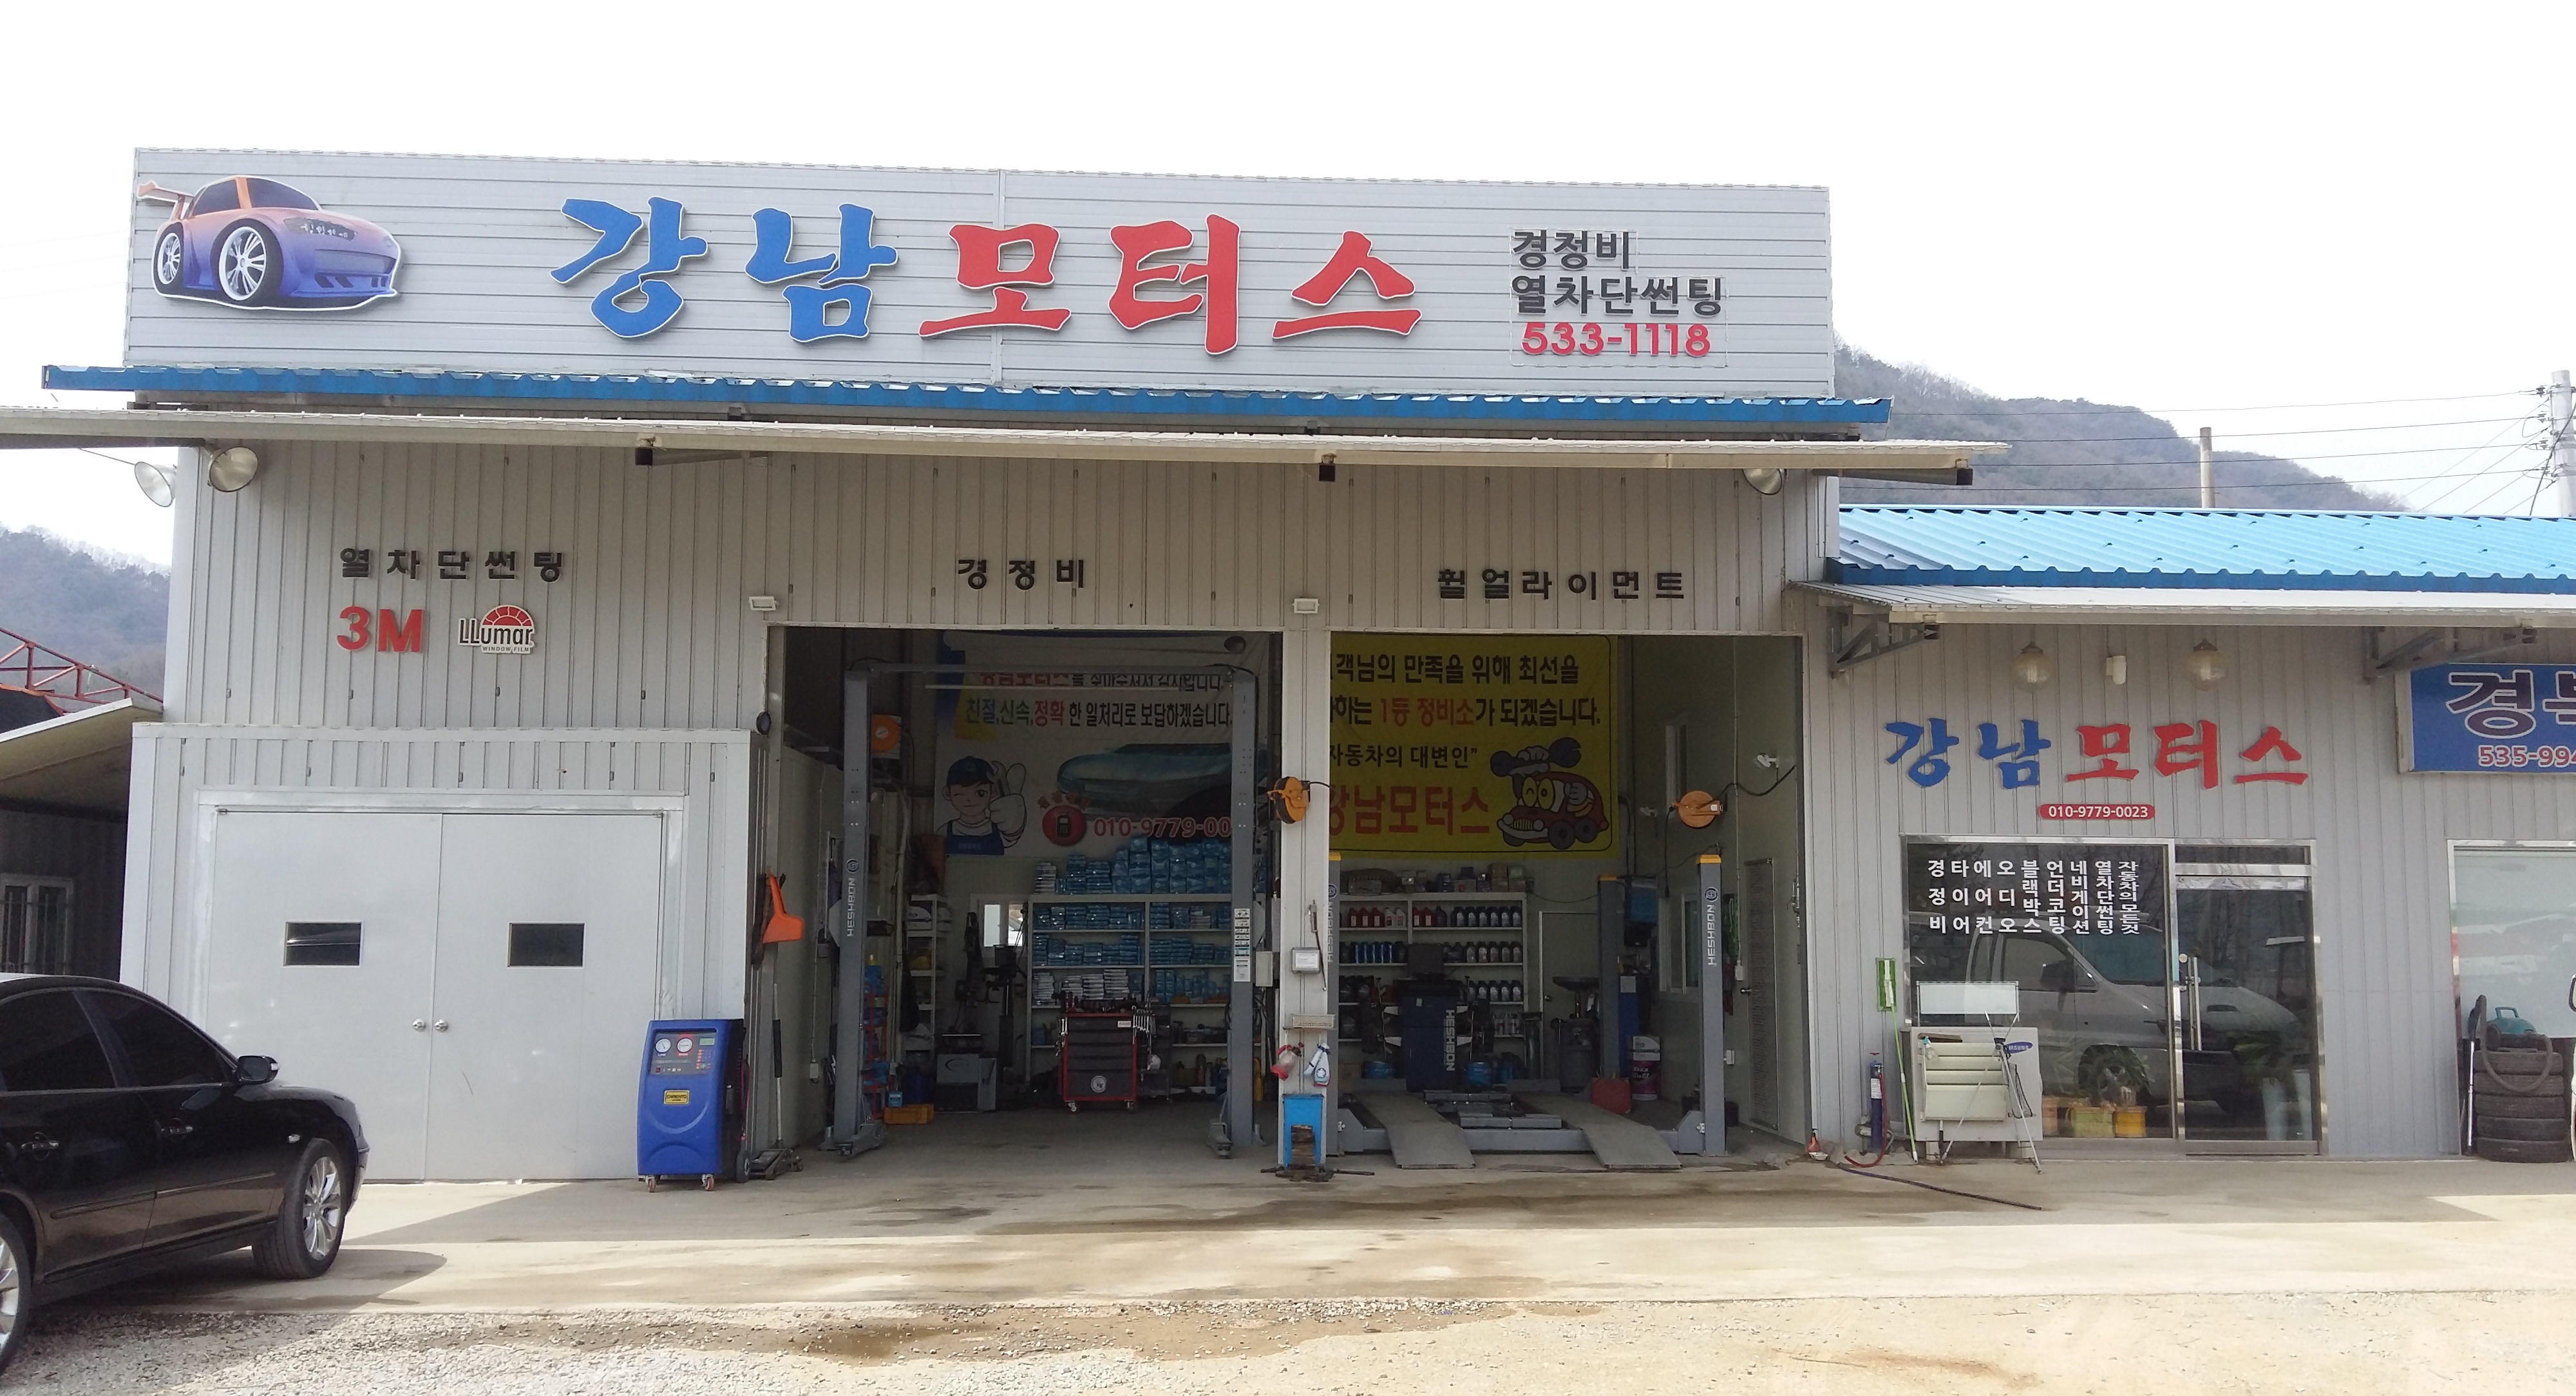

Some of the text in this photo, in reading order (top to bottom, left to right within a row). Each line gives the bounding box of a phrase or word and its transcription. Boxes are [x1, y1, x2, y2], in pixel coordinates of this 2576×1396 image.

[549, 195, 1423, 356] 강남모터스
[1511, 229, 1630, 271] 경정비
[1511, 274, 1722, 318] 열차단썬팅
[1520, 321, 1711, 357] 533-1118
[340, 547, 563, 582] 열차단썬팅
[958, 559, 1084, 590] 경정비
[1437, 569, 1685, 601] 휠얼라이먼트
[337, 606, 423, 652] 3M
[459, 619, 533, 645] LLumar
[1331, 654, 1579, 684] 객님의 만족을 위해 최선을
[1086, 702, 1136, 727] 일처리로
[1141, 703, 1233, 728] 보답하겠습니다.
[1331, 695, 1600, 728] 하는 1등 정비소가 되겠습니다.
[1885, 717, 2308, 789] 강남모터스
[1093, 816, 1231, 838] 010-9779-00
[1329, 785, 1490, 836] 강남모터스
[2049, 806, 2148, 818] 010-9779-0023
[847, 878, 856, 937] HESHBON
[1927, 860, 1947, 934] 경정비
[1951, 860, 1970, 934] 타이어
[1973, 860, 1993, 934] 에어컨
[1996, 860, 2018, 934] 오디오
[2021, 860, 2042, 934] 블랙박스
[2046, 860, 2066, 934] 언더코팅
[2070, 860, 2090, 935] 네비게이션
[2095, 860, 2115, 935] 열차단썬팅
[1707, 904, 1716, 966] HESHBON
[1445, 1009, 1455, 1071] HESHBON
